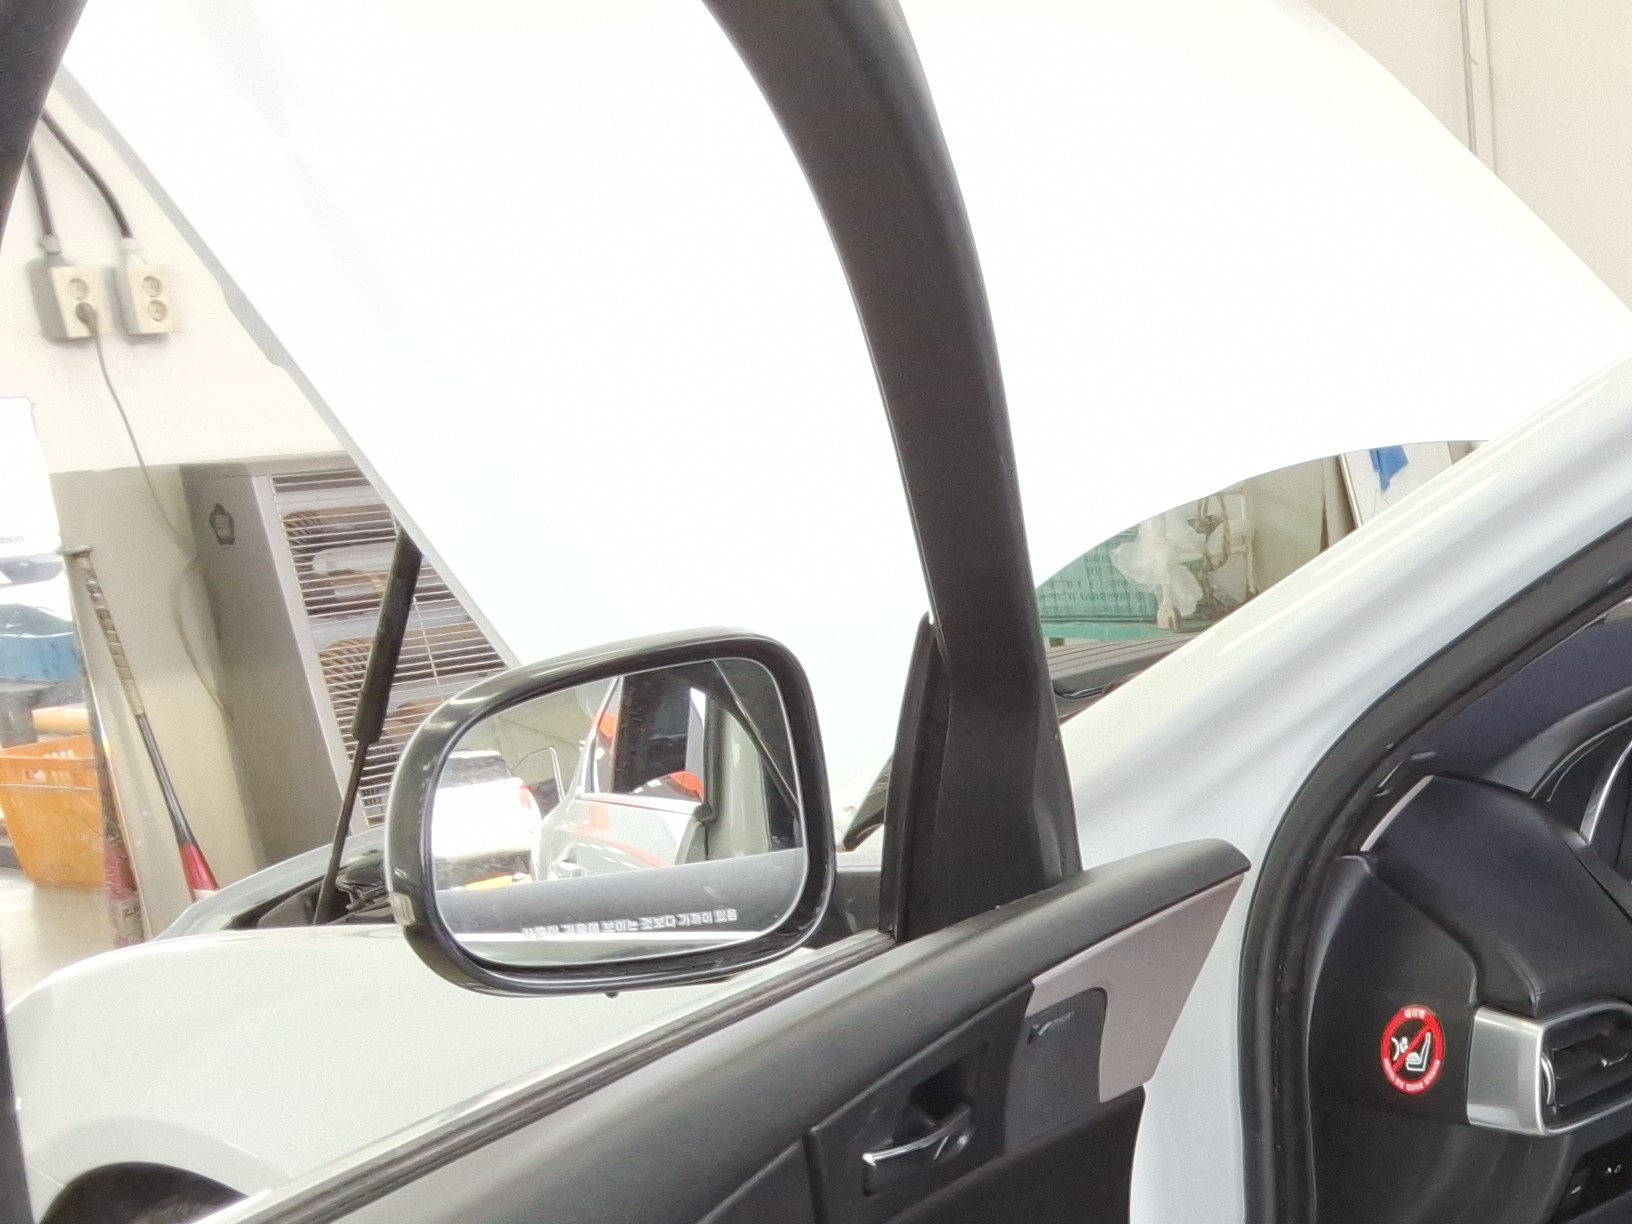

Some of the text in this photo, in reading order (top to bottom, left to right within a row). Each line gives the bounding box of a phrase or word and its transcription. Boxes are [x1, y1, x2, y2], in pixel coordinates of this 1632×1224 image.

[600, 919, 639, 933] 보이는
[639, 914, 676, 931] 것보다
[675, 911, 713, 927] 가까이
[713, 908, 738, 923] 있음
